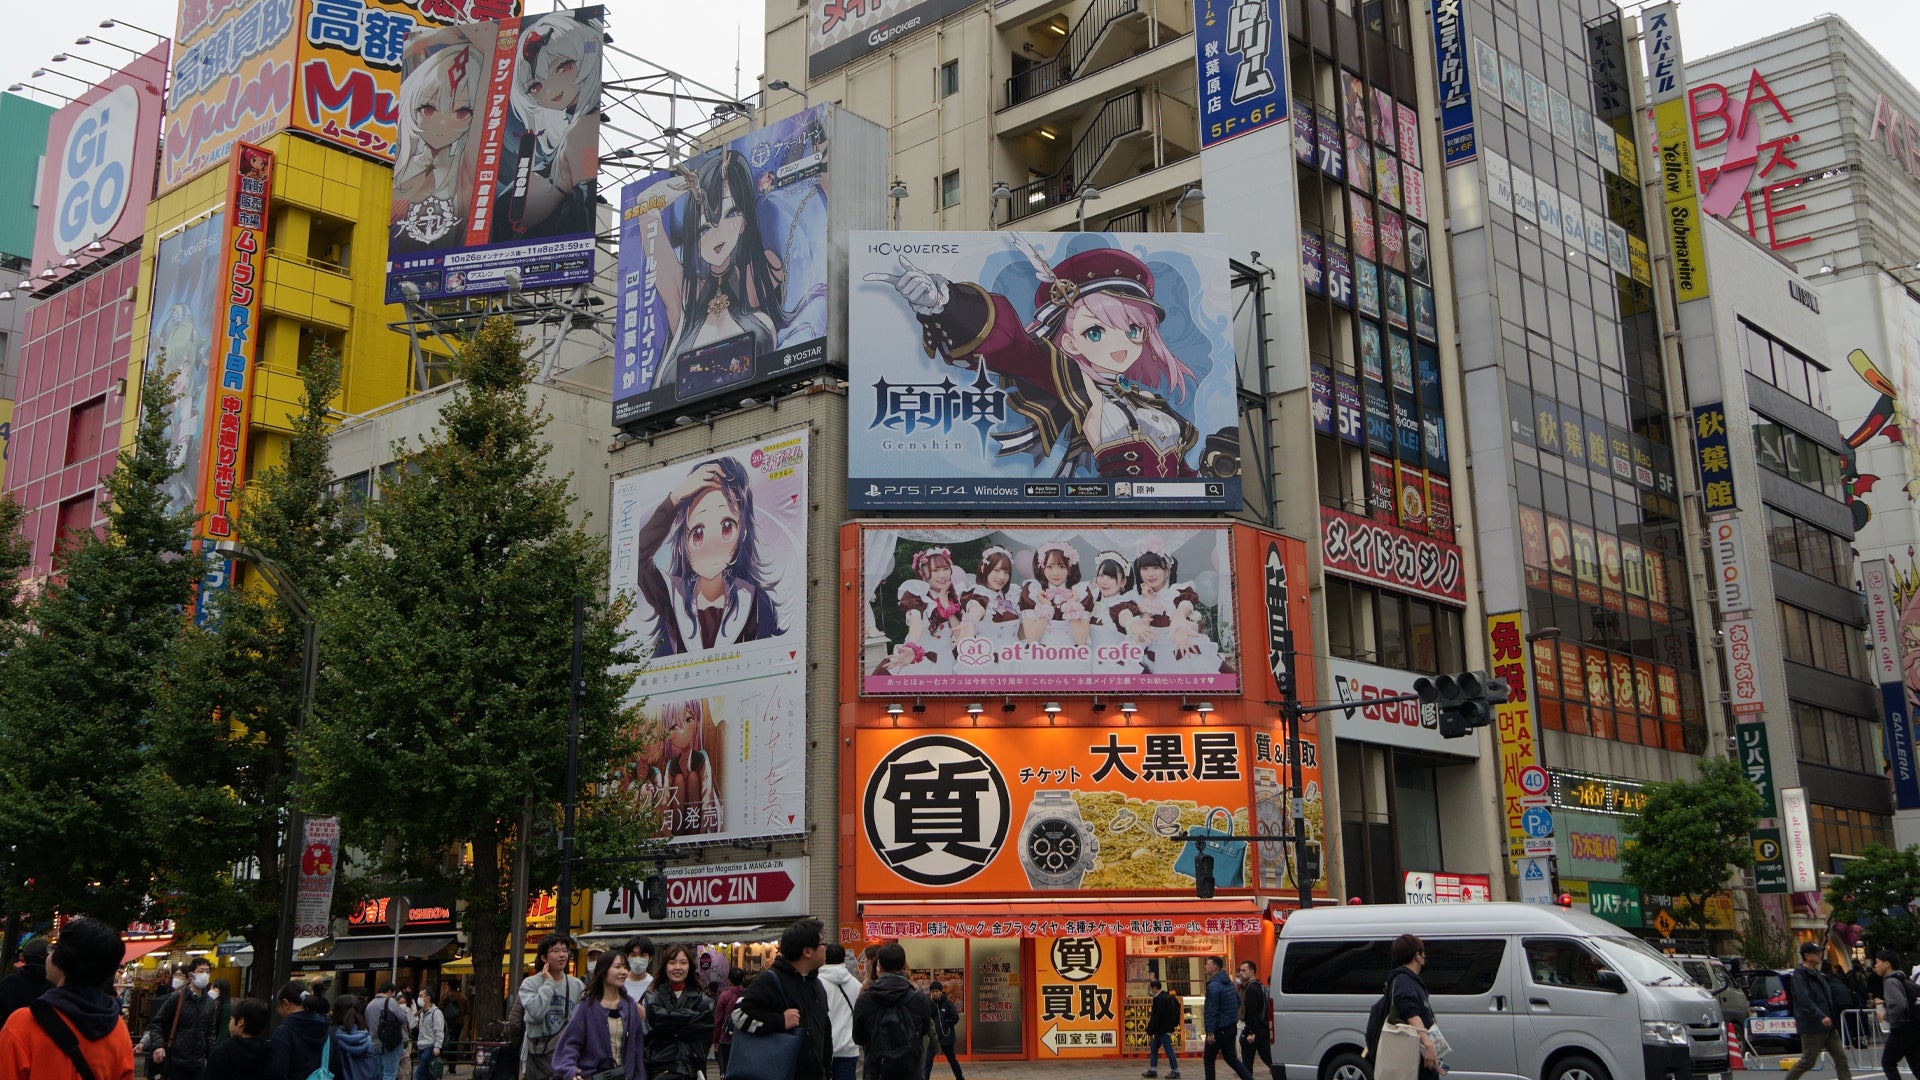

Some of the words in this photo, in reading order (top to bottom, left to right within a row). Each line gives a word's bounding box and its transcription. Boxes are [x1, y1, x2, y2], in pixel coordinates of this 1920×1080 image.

[868, 16, 921, 46] GGPOKER
[171, 1, 293, 111] 高額買取
[1649, 13, 1676, 94] スーパービル
[1204, 41, 1221, 114] 秋葉原店
[322, 120, 388, 152] ムーラン
[173, 153, 208, 183] ムーラン
[1319, 145, 1342, 177] 7F
[1662, 143, 1682, 194] Yellow
[1681, 141, 1690, 170] HOBBY
[241, 178, 263, 195] 買取
[1685, 170, 1693, 188] BASE
[240, 194, 263, 212] 販売
[623, 202, 647, 220] SSR
[239, 212, 261, 228] 市場
[1538, 200, 1561, 229] ON
[1564, 214, 1606, 254] SALE!
[868, 242, 960, 255] HOYOVERSE
[1670, 206, 1693, 292] Submarine
[229, 228, 256, 306] ムーラン
[627, 273, 638, 285] CV
[1328, 270, 1351, 301] 6F
[640, 220, 659, 386] ゴールデン・ハインド
[222, 305, 250, 391] AKIBA
[791, 346, 822, 363] YOSTAR
[868, 355, 1006, 460] 原神
[1338, 404, 1361, 437] 5F
[1367, 416, 1384, 439] ON
[1539, 411, 1608, 469] 秋葉館
[883, 440, 962, 449] Genshin
[1696, 410, 1733, 509] 秋葉館
[884, 486, 920, 495] PS5
[930, 486, 966, 495] PS4
[974, 485, 1018, 496] Windows
[1136, 485, 1155, 495] 原神
[1658, 472, 1674, 494] 5F
[1325, 517, 1459, 593] メイドカジノ
[1718, 524, 1742, 608] amiami
[1873, 593, 1888, 643] at-home
[967, 642, 983, 655] at
[1001, 643, 1089, 661] at-home
[1097, 643, 1142, 661] cafe
[1729, 624, 1756, 699] あみあみ
[1880, 646, 1893, 673] cafe
[1536, 660, 1552, 676] Tax
[1515, 709, 1533, 758] TAX
[1892, 712, 1910, 781] GALLERIA
[1019, 766, 1081, 783] チケット
[1089, 731, 1241, 783] 大黒屋
[1525, 773, 1542, 788] 40
[641, 786, 680, 809] ックス
[882, 757, 997, 867] 質
[1528, 816, 1541, 834] P
[1791, 816, 1804, 857] at-home
[1570, 832, 1619, 864] 乃木坂46
[1763, 842, 1774, 858] P
[683, 866, 705, 877] Support
[706, 865, 715, 874] for
[715, 863, 743, 875] Magazine
[749, 860, 784, 869] MANGA-ZIN
[1776, 876, 1786, 885] IN
[728, 876, 757, 902] ZIN
[1591, 892, 1638, 914] リバティー
[408, 906, 450, 920] OSHINOYA
[865, 921, 922, 937] 高価買取
[1206, 918, 1262, 933] 無料査定
[1057, 937, 1097, 975] 質
[1041, 983, 1115, 1021] 買取
[1054, 1031, 1113, 1045] 個室完備
